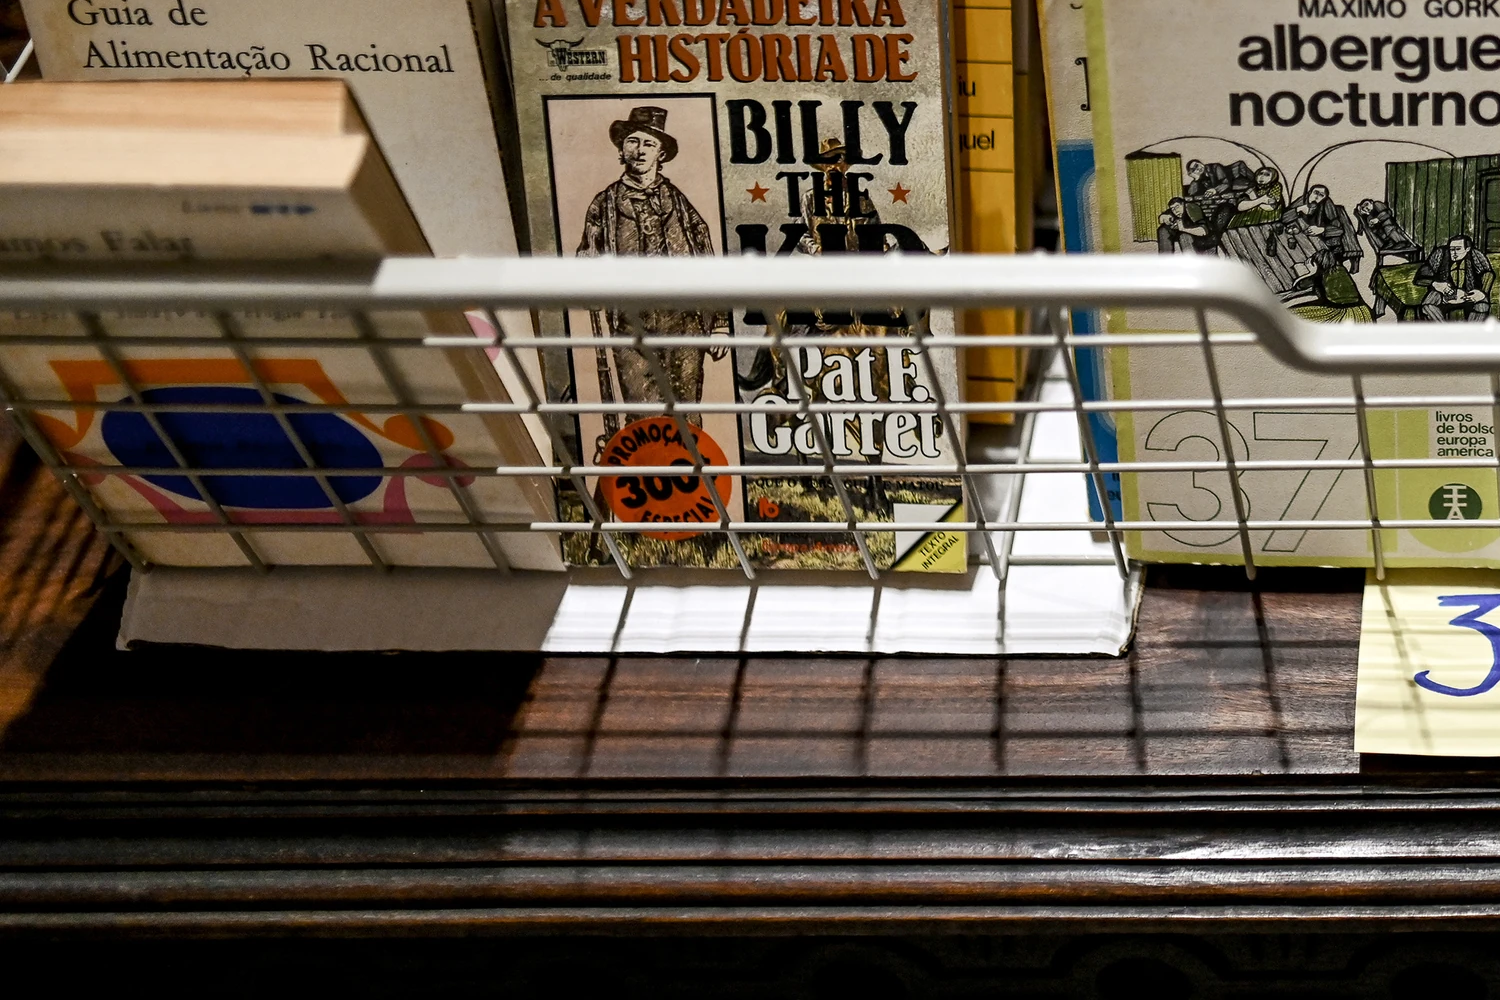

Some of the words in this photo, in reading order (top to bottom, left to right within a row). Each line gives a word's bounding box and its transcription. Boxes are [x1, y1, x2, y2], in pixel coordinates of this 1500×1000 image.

[168, 0, 209, 27] de
[83, 40, 291, 77] Alimentação
[306, 42, 455, 73] Racional
[616, 28, 850, 85] HISTÓRIA
[854, 33, 919, 84] DE
[565, 72, 612, 82] qualidade
[725, 97, 919, 167] BILLY
[776, 171, 877, 218] THE
[786, 343, 878, 403] Pat
[750, 393, 941, 458] Garret
[1435, 410, 1473, 422] livros
[1436, 422, 1455, 434] de
[1436, 435, 1487, 447] europa
[1145, 408, 1362, 553] 37
[919, 531, 947, 558] TEXTO
[921, 534, 960, 571] INTEGRAL
